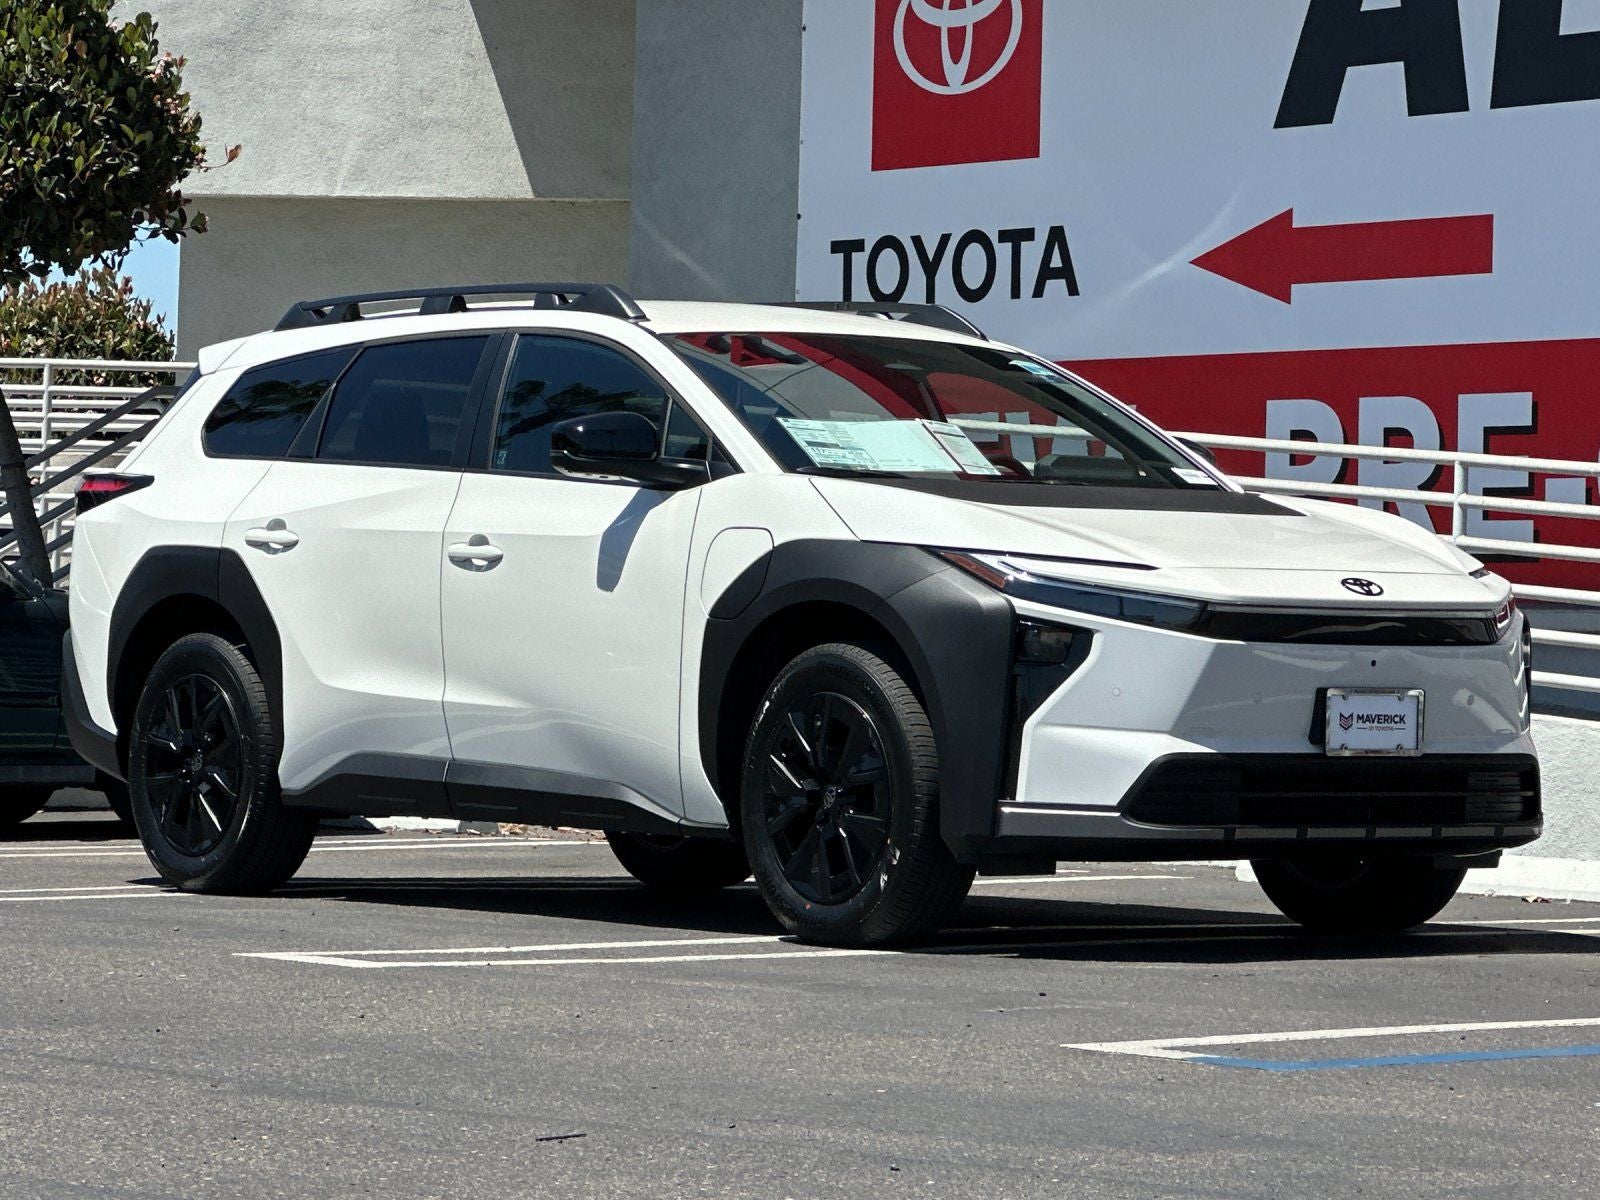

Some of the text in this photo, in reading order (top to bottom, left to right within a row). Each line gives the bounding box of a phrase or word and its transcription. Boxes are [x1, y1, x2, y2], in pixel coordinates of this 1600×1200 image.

[831, 225, 1080, 304] TOYOTA
[1264, 391, 1600, 562] PRE-
[1356, 713, 1407, 725] MAVERICK
